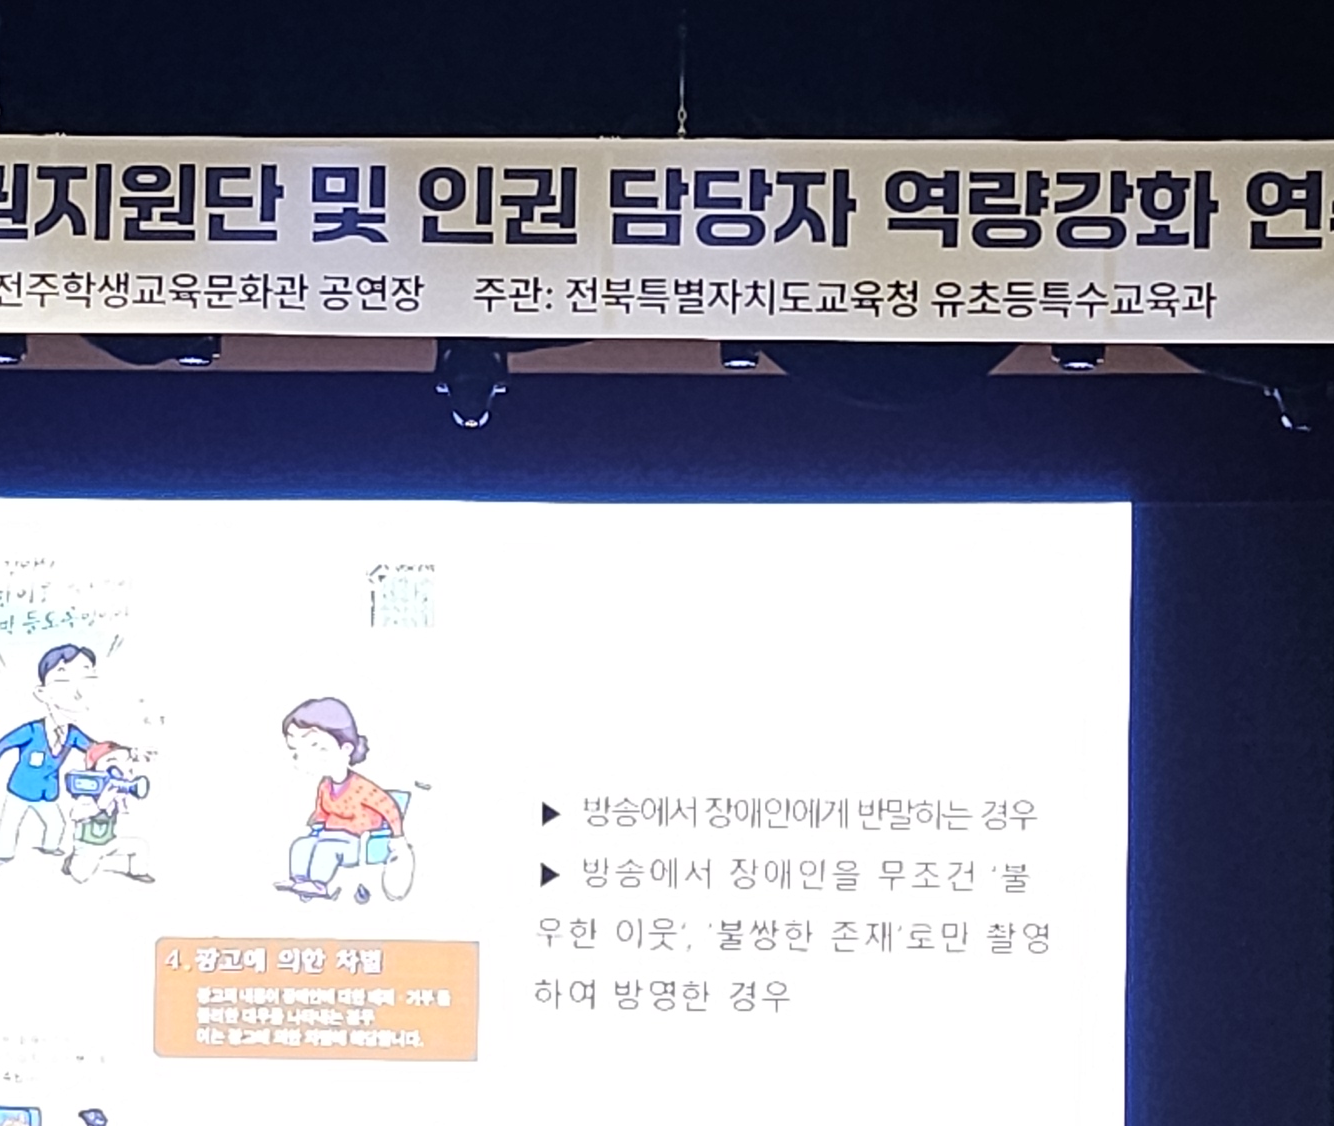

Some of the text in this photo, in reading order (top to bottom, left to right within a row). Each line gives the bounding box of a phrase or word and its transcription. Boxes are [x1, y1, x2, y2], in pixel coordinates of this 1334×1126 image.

[312, 166, 388, 242] 및
[419, 167, 577, 244] 인권
[610, 168, 856, 247] 담당자
[886, 171, 1219, 249] 역량강화
[320, 276, 424, 311] 공연장
[474, 277, 1216, 318] 주관: 전북특별자치도교육청 유초등특수교육과
[584, 796, 1038, 831] 방송에서 장애인에게 반말하는 경우
[583, 857, 711, 889] 방송에서
[730, 859, 860, 891] 장애인을
[878, 861, 973, 891] 무조건
[538, 918, 596, 949] 우한
[987, 922, 1048, 954] 촬영
[195, 948, 267, 973] 광고에
[277, 948, 327, 974] 의한
[336, 949, 383, 975] 차별
[535, 979, 790, 1013] 하여 방영한 경우
